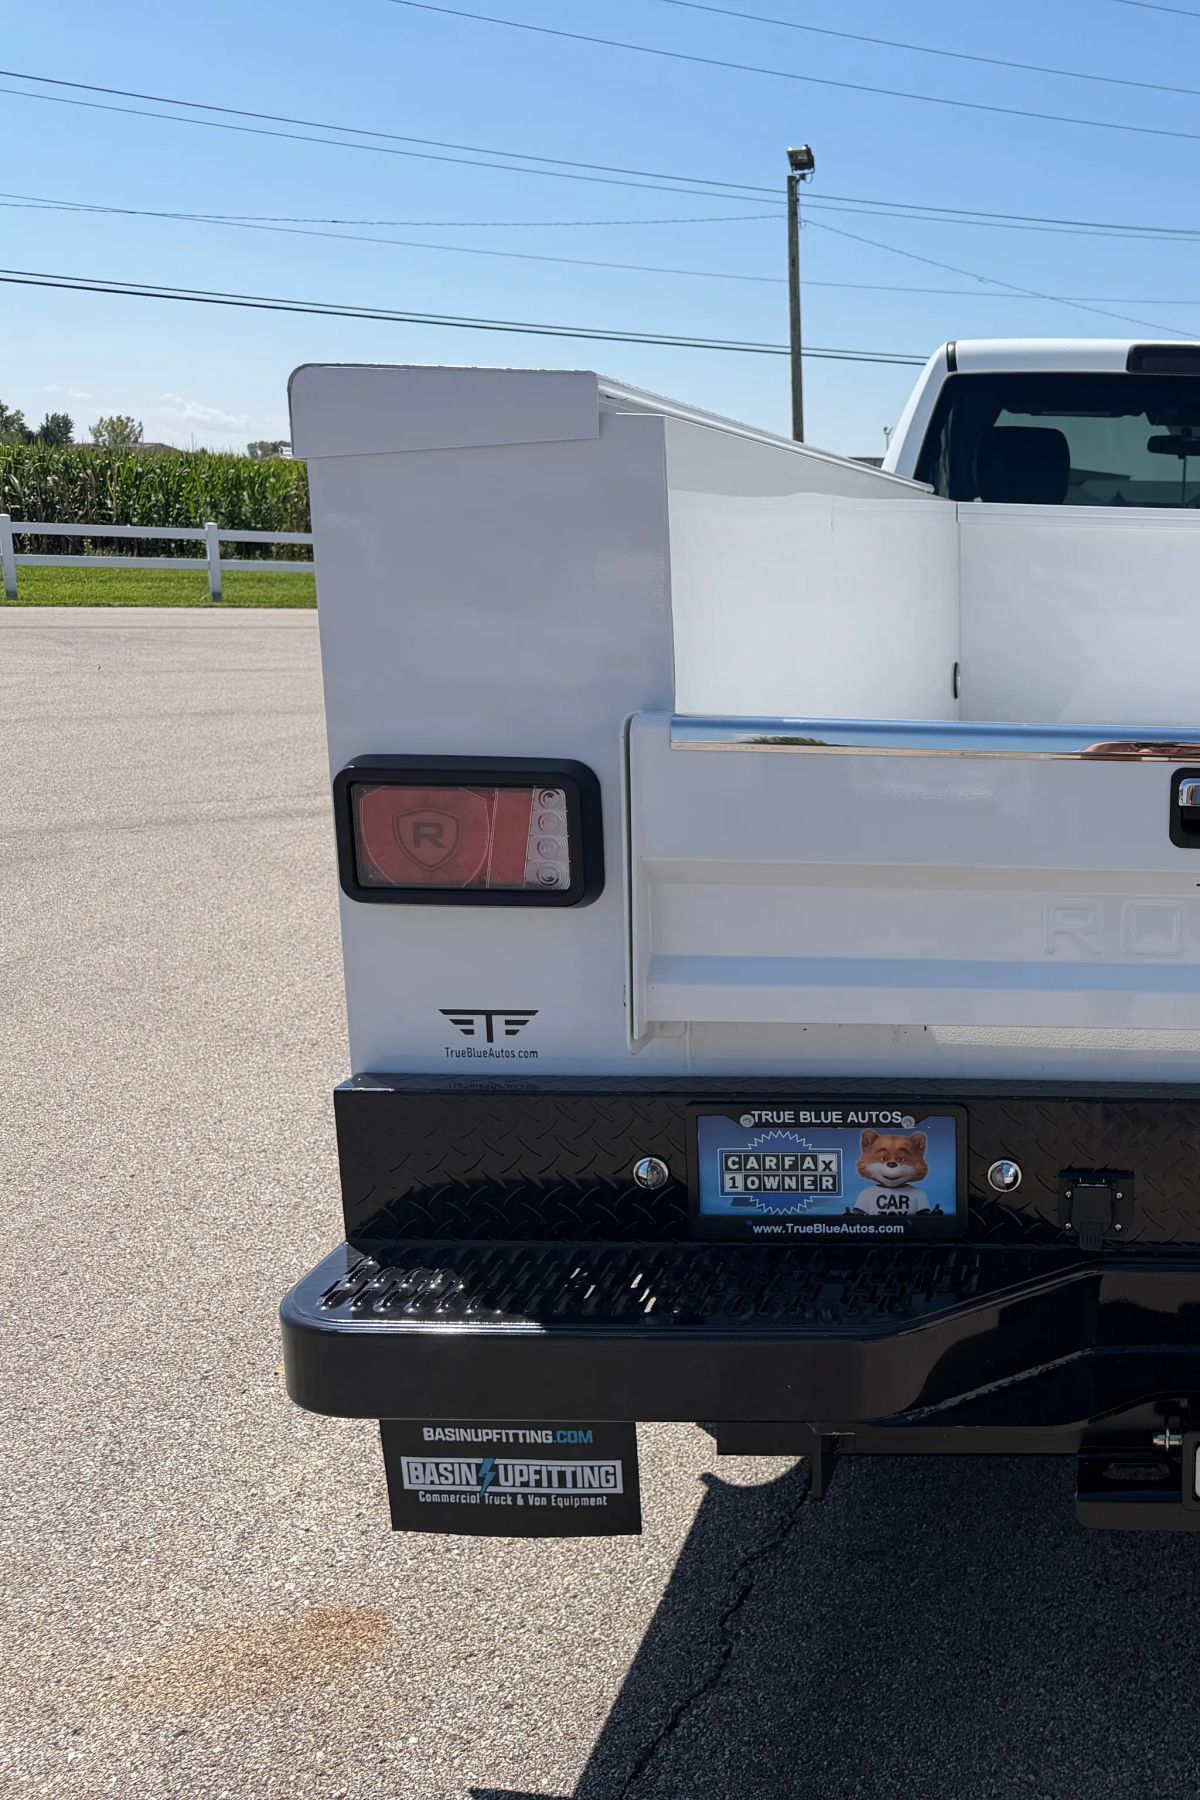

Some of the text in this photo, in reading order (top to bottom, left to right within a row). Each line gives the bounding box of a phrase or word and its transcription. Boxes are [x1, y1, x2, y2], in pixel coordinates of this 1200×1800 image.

[445, 1047, 538, 1059] TrueBlueAutos.com
[752, 1110, 902, 1124] TRUE BLUE AUTOS
[726, 1154, 836, 1172] CARFAX
[875, 1195, 910, 1209] CAR
[753, 1223, 904, 1234] www.TrueBlueAutos.com
[423, 1427, 593, 1444] BASINUPFITTING.COM
[409, 1462, 615, 1488] BASIN UPFITTING
[418, 1491, 607, 1508] Commercial Truck & Van Equipment
